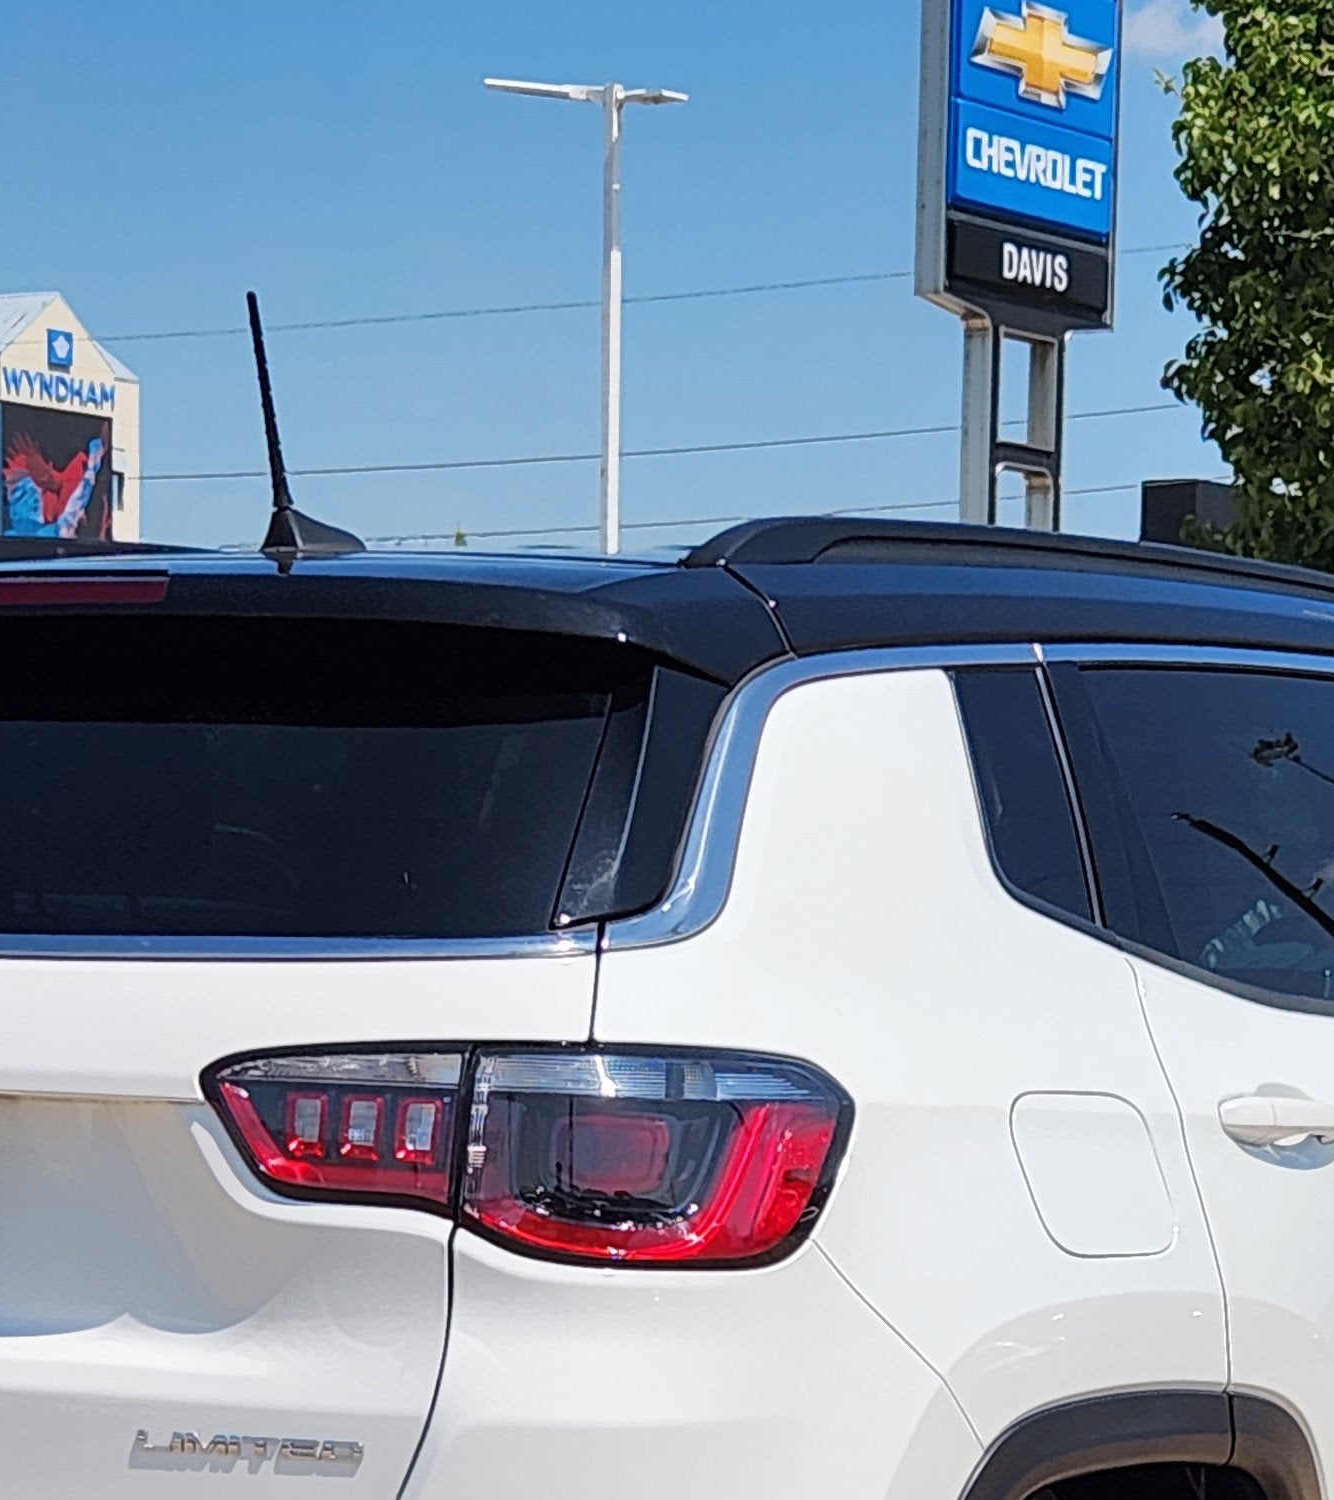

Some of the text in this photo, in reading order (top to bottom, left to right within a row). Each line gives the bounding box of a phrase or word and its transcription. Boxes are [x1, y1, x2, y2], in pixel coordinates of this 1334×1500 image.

[965, 127, 1108, 201] CHEVROLET
[1002, 242, 1069, 292] DAVIS
[2, 366, 116, 411] WYNDHAM
[129, 1429, 365, 1471] LIMITED
